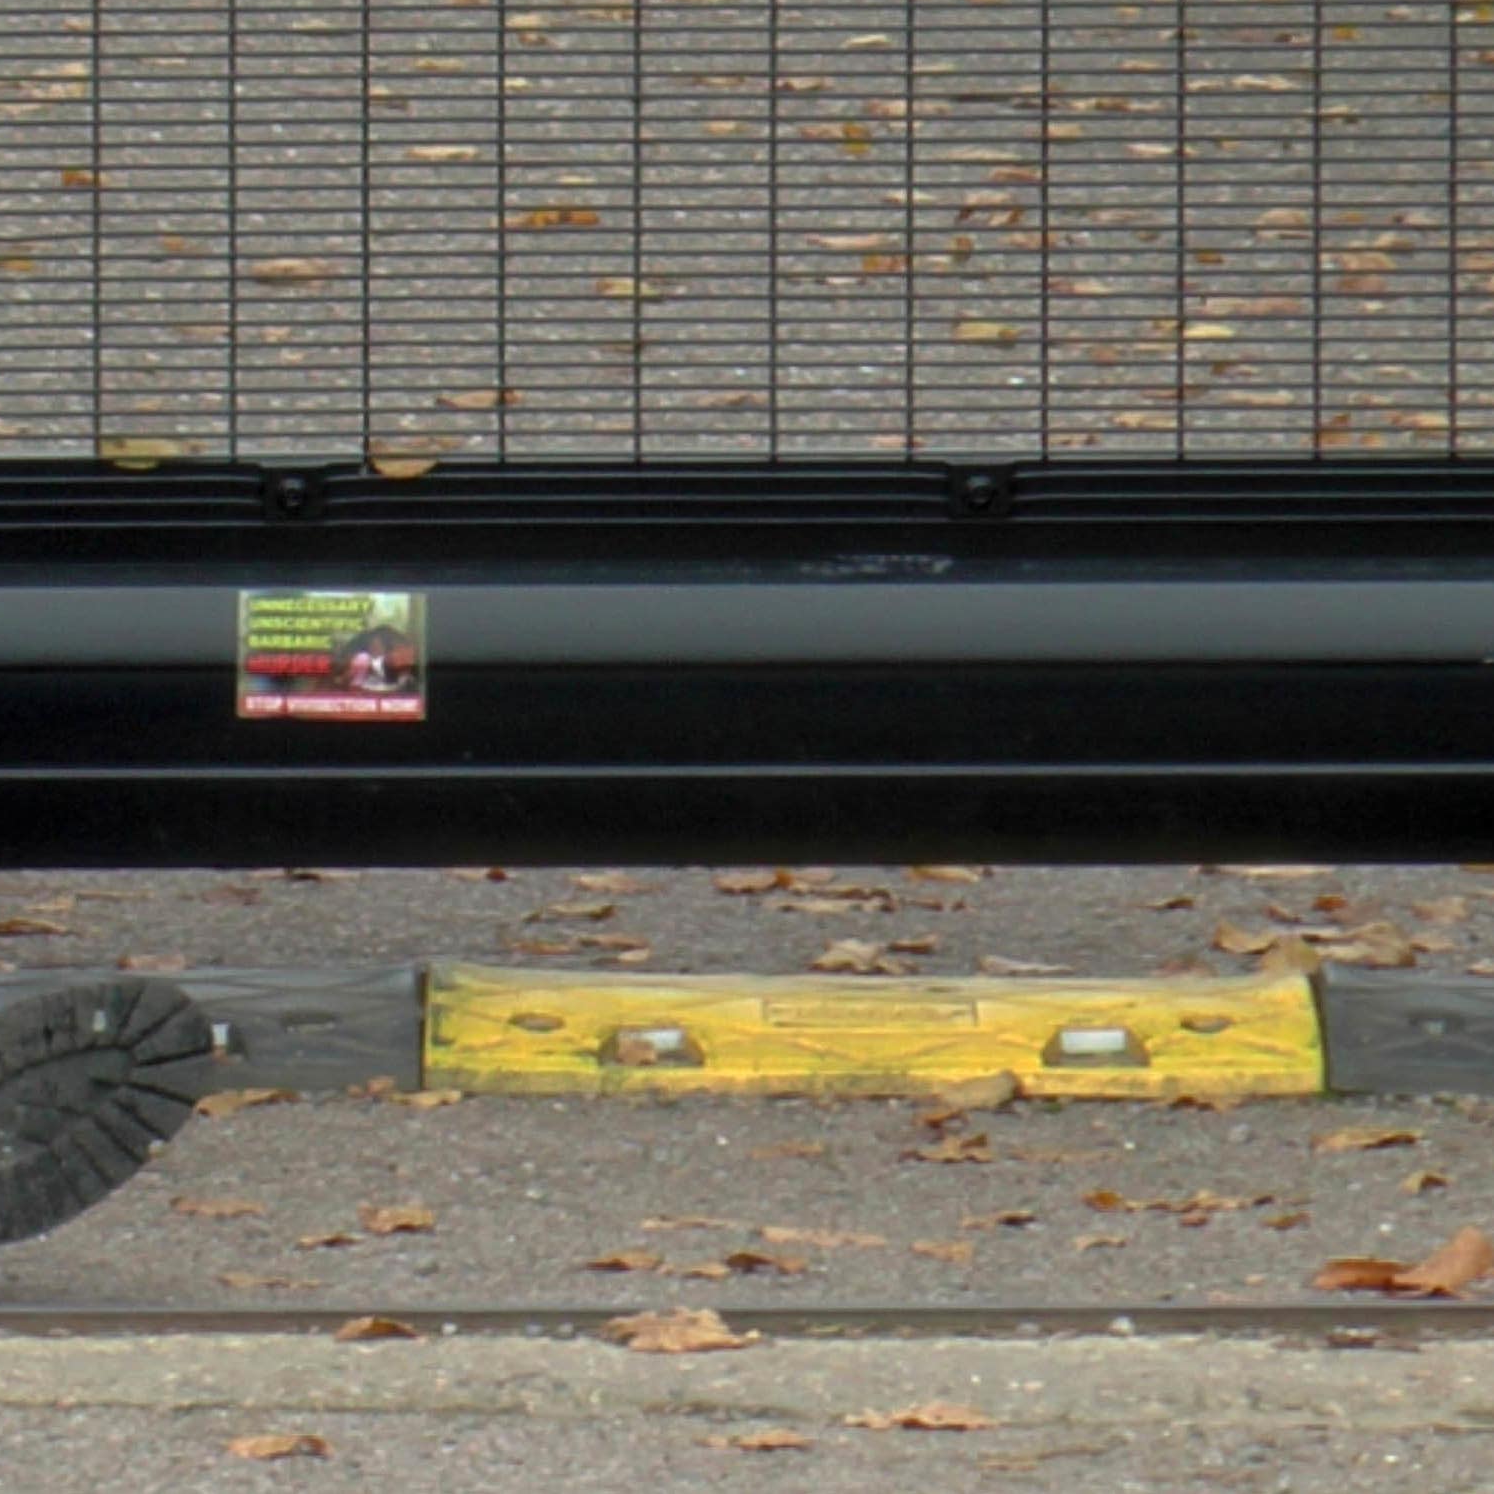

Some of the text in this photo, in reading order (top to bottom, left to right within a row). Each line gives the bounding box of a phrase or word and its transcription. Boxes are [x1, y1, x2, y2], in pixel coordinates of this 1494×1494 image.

[249, 598, 372, 612] UNNECESSARY
[249, 617, 364, 631] UNSCIENTIFIC
[248, 635, 332, 649] BARBARIC
[247, 655, 331, 673] MURDER
[245, 696, 282, 710] STOP
